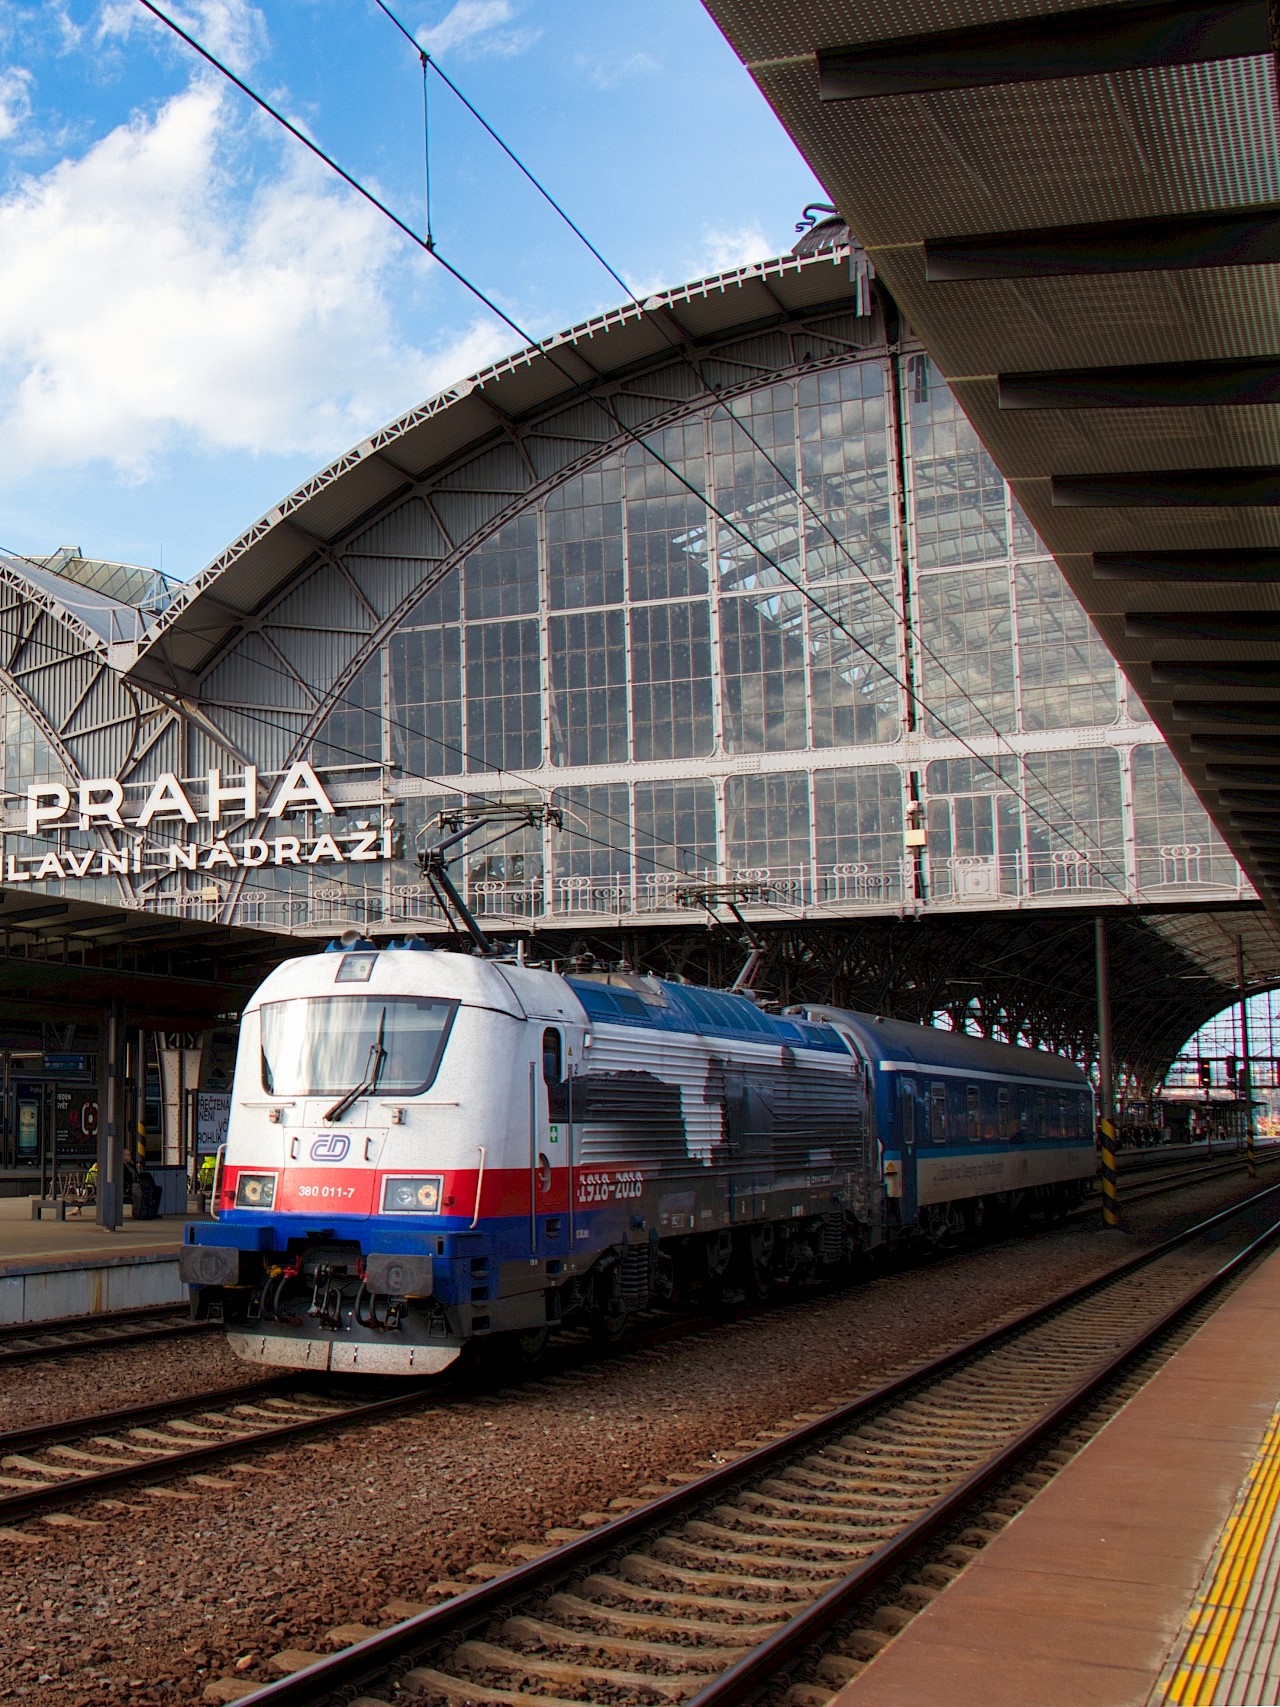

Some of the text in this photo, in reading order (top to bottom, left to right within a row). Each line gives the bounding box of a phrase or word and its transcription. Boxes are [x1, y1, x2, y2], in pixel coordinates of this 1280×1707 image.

[26, 761, 335, 835] PRAHA
[169, 818, 395, 871] NÁDRAŽÍ
[298, 1185, 355, 1198] 380 011-7
[579, 1171, 643, 1202] 1918-2018
